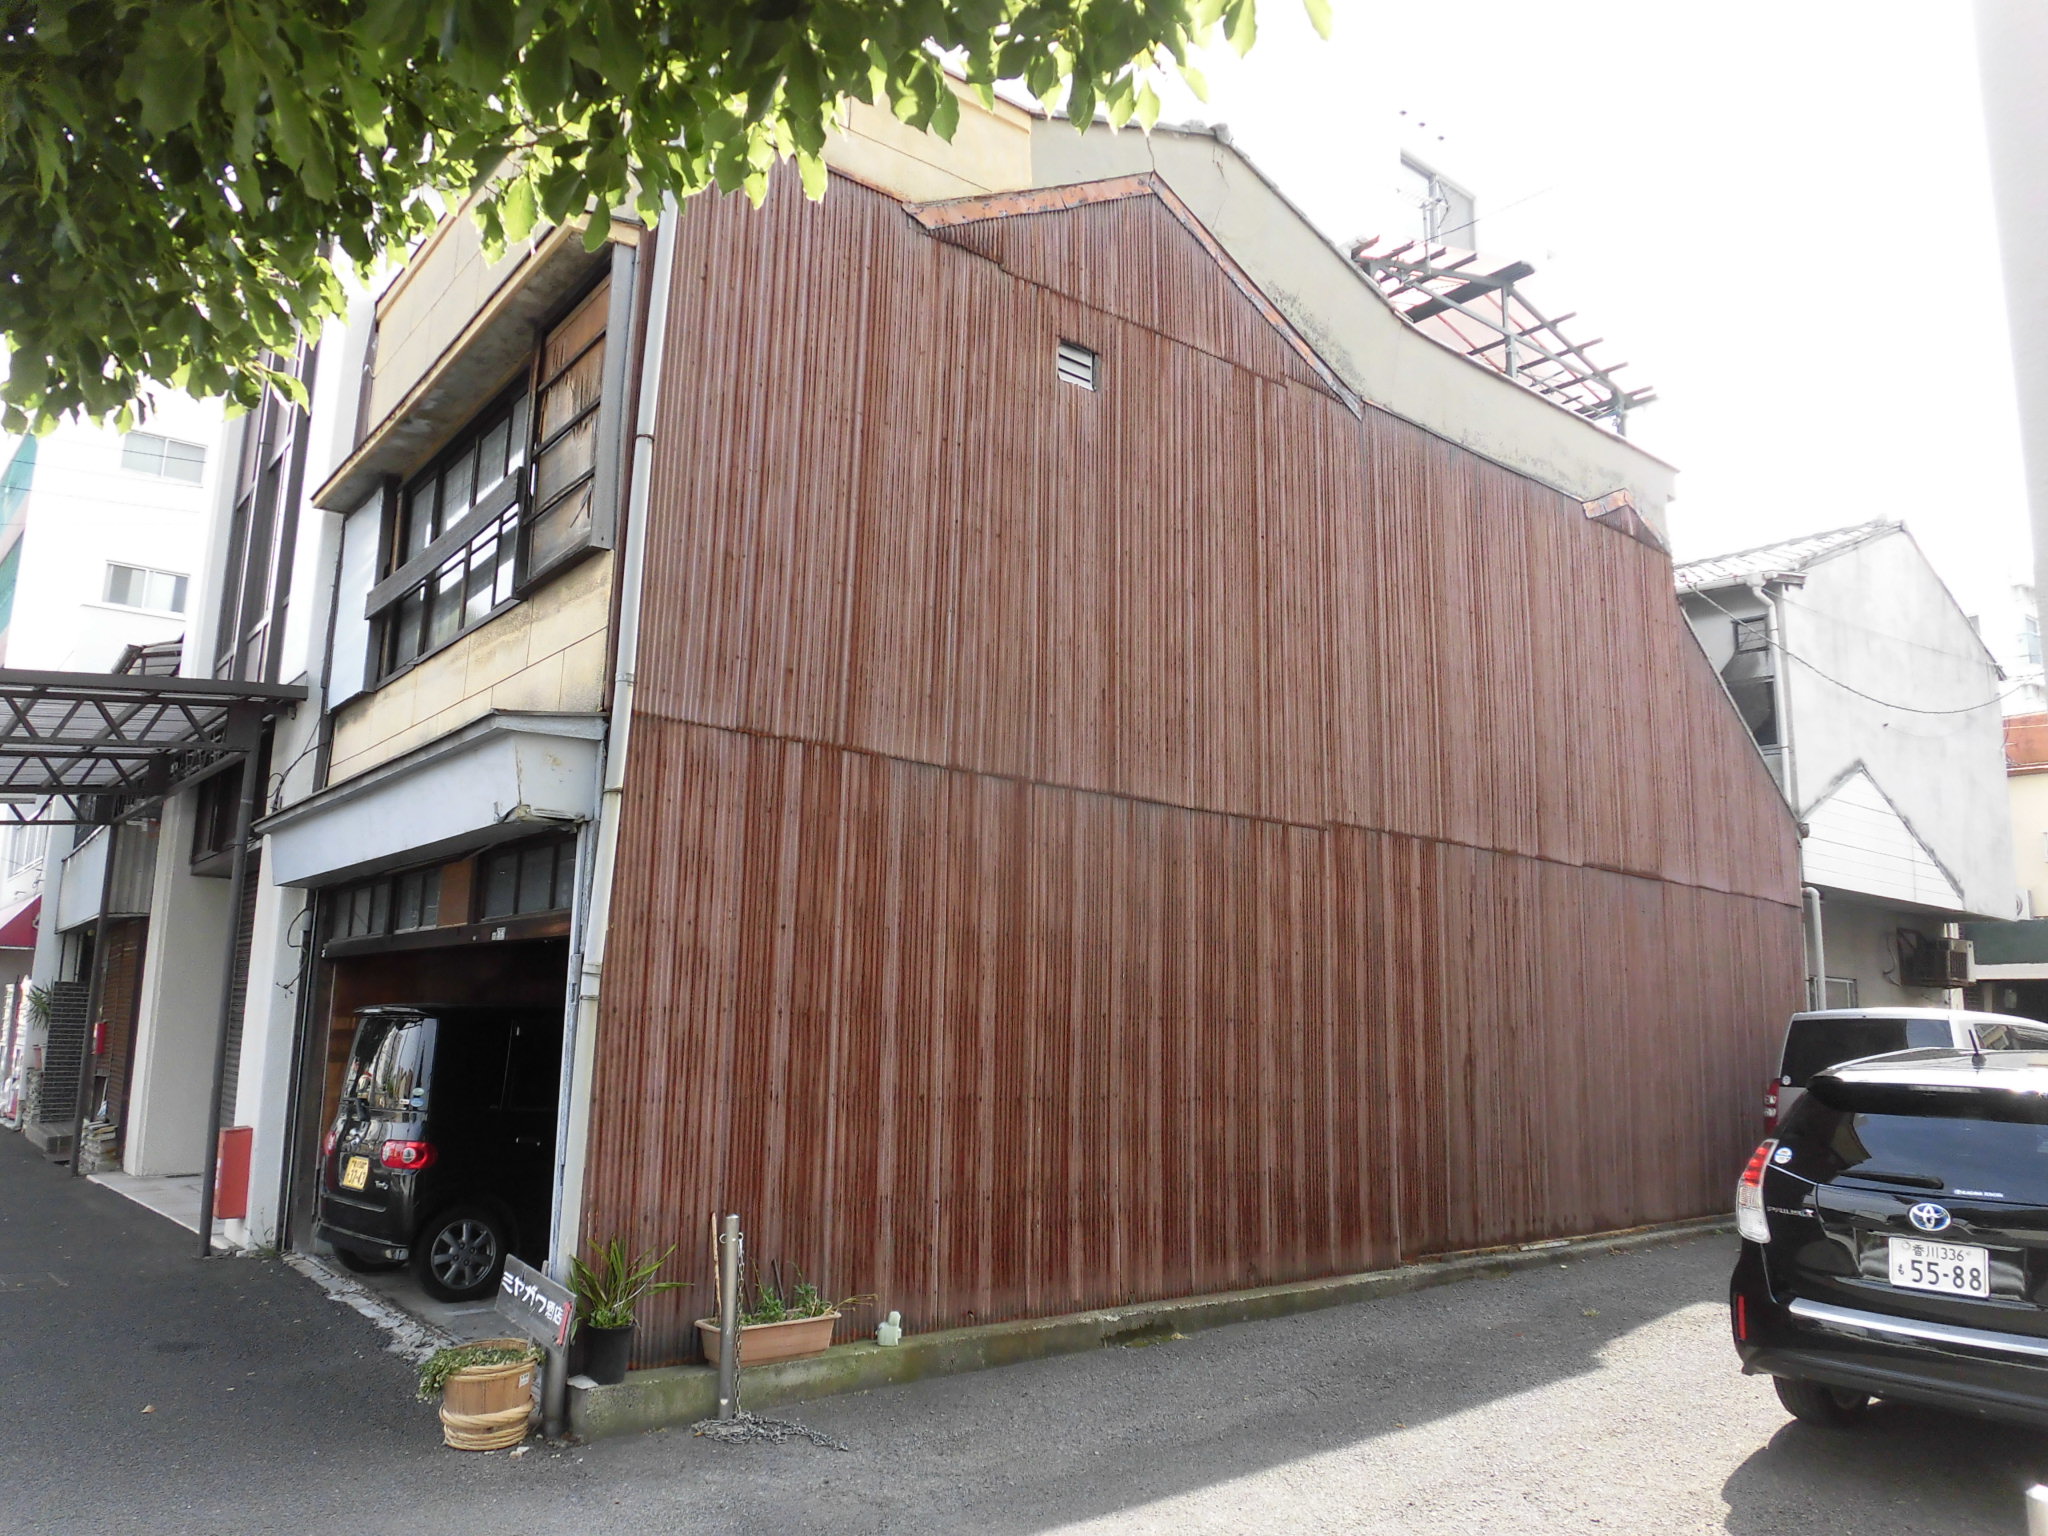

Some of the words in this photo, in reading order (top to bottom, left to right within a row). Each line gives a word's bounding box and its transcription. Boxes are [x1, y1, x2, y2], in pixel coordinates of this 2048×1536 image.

[1911, 1260, 1982, 1291] 55-88
[501, 1271, 564, 1326] ミヤガワ酒店
